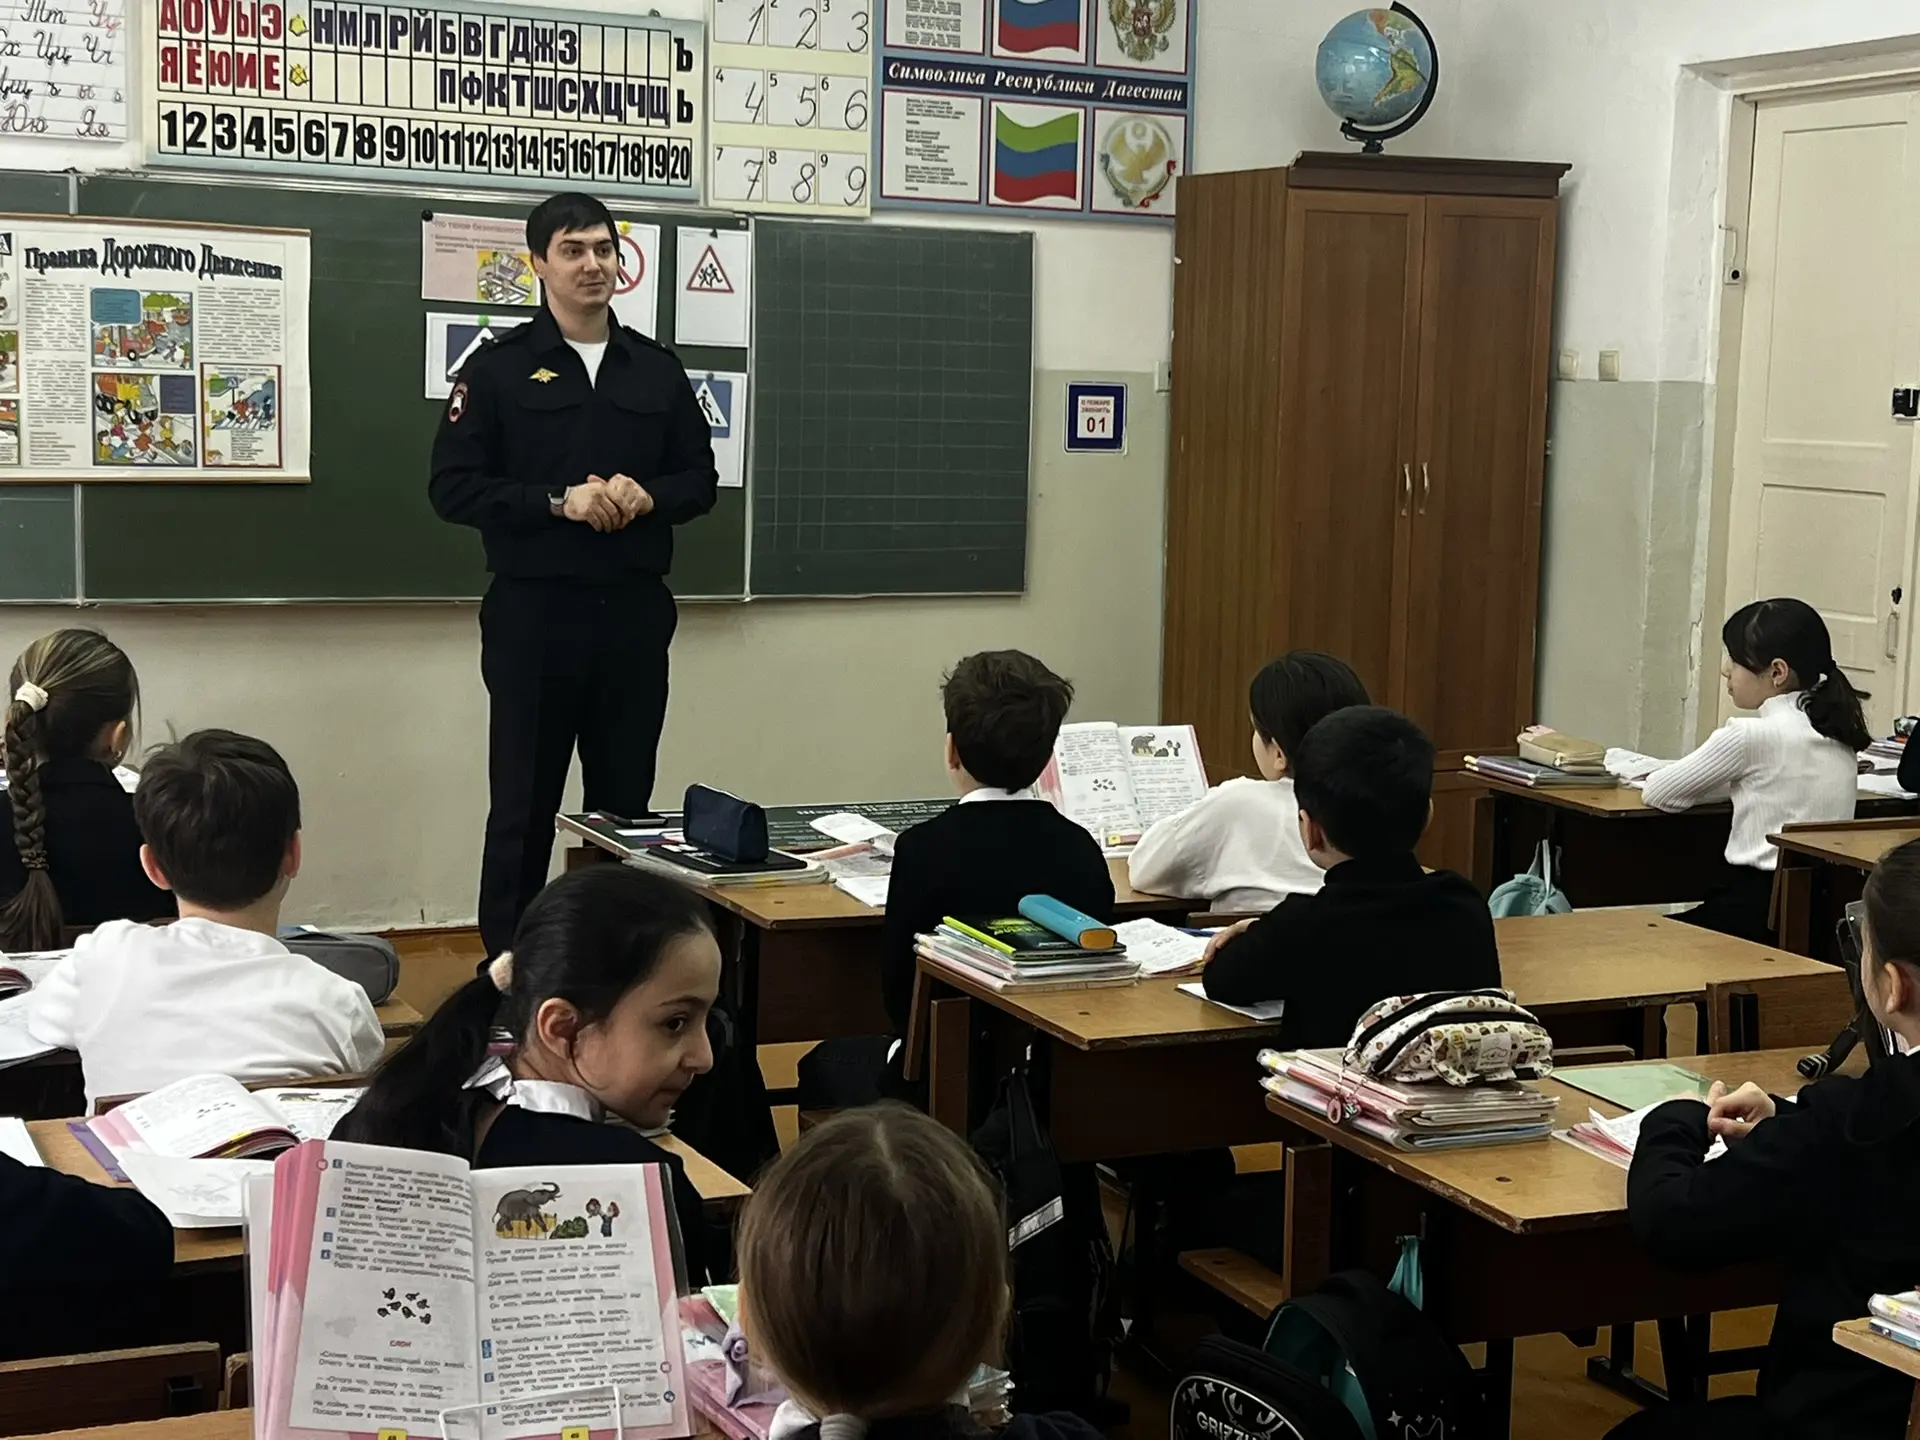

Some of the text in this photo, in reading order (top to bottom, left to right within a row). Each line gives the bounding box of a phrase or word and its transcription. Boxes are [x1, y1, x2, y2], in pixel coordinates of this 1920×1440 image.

[795, 8, 817, 48] 2
[847, 12, 868, 52] 3
[716, 69, 867, 130] 4 4 5 5 6 6
[888, 62, 1184, 102] Символика Республики Дагестан
[162, 110, 690, 181] 1 2 3 4 5 6 7 8 9 10 11 12 13 14 15 16 17 18 19 20
[716, 148, 866, 206] 7 7 8 8 9 9
[24, 237, 283, 281] Правила Дорожного Движения
[1086, 416, 1106, 433] 01
[1196, 1411, 1257, 1440] GRIZZ
